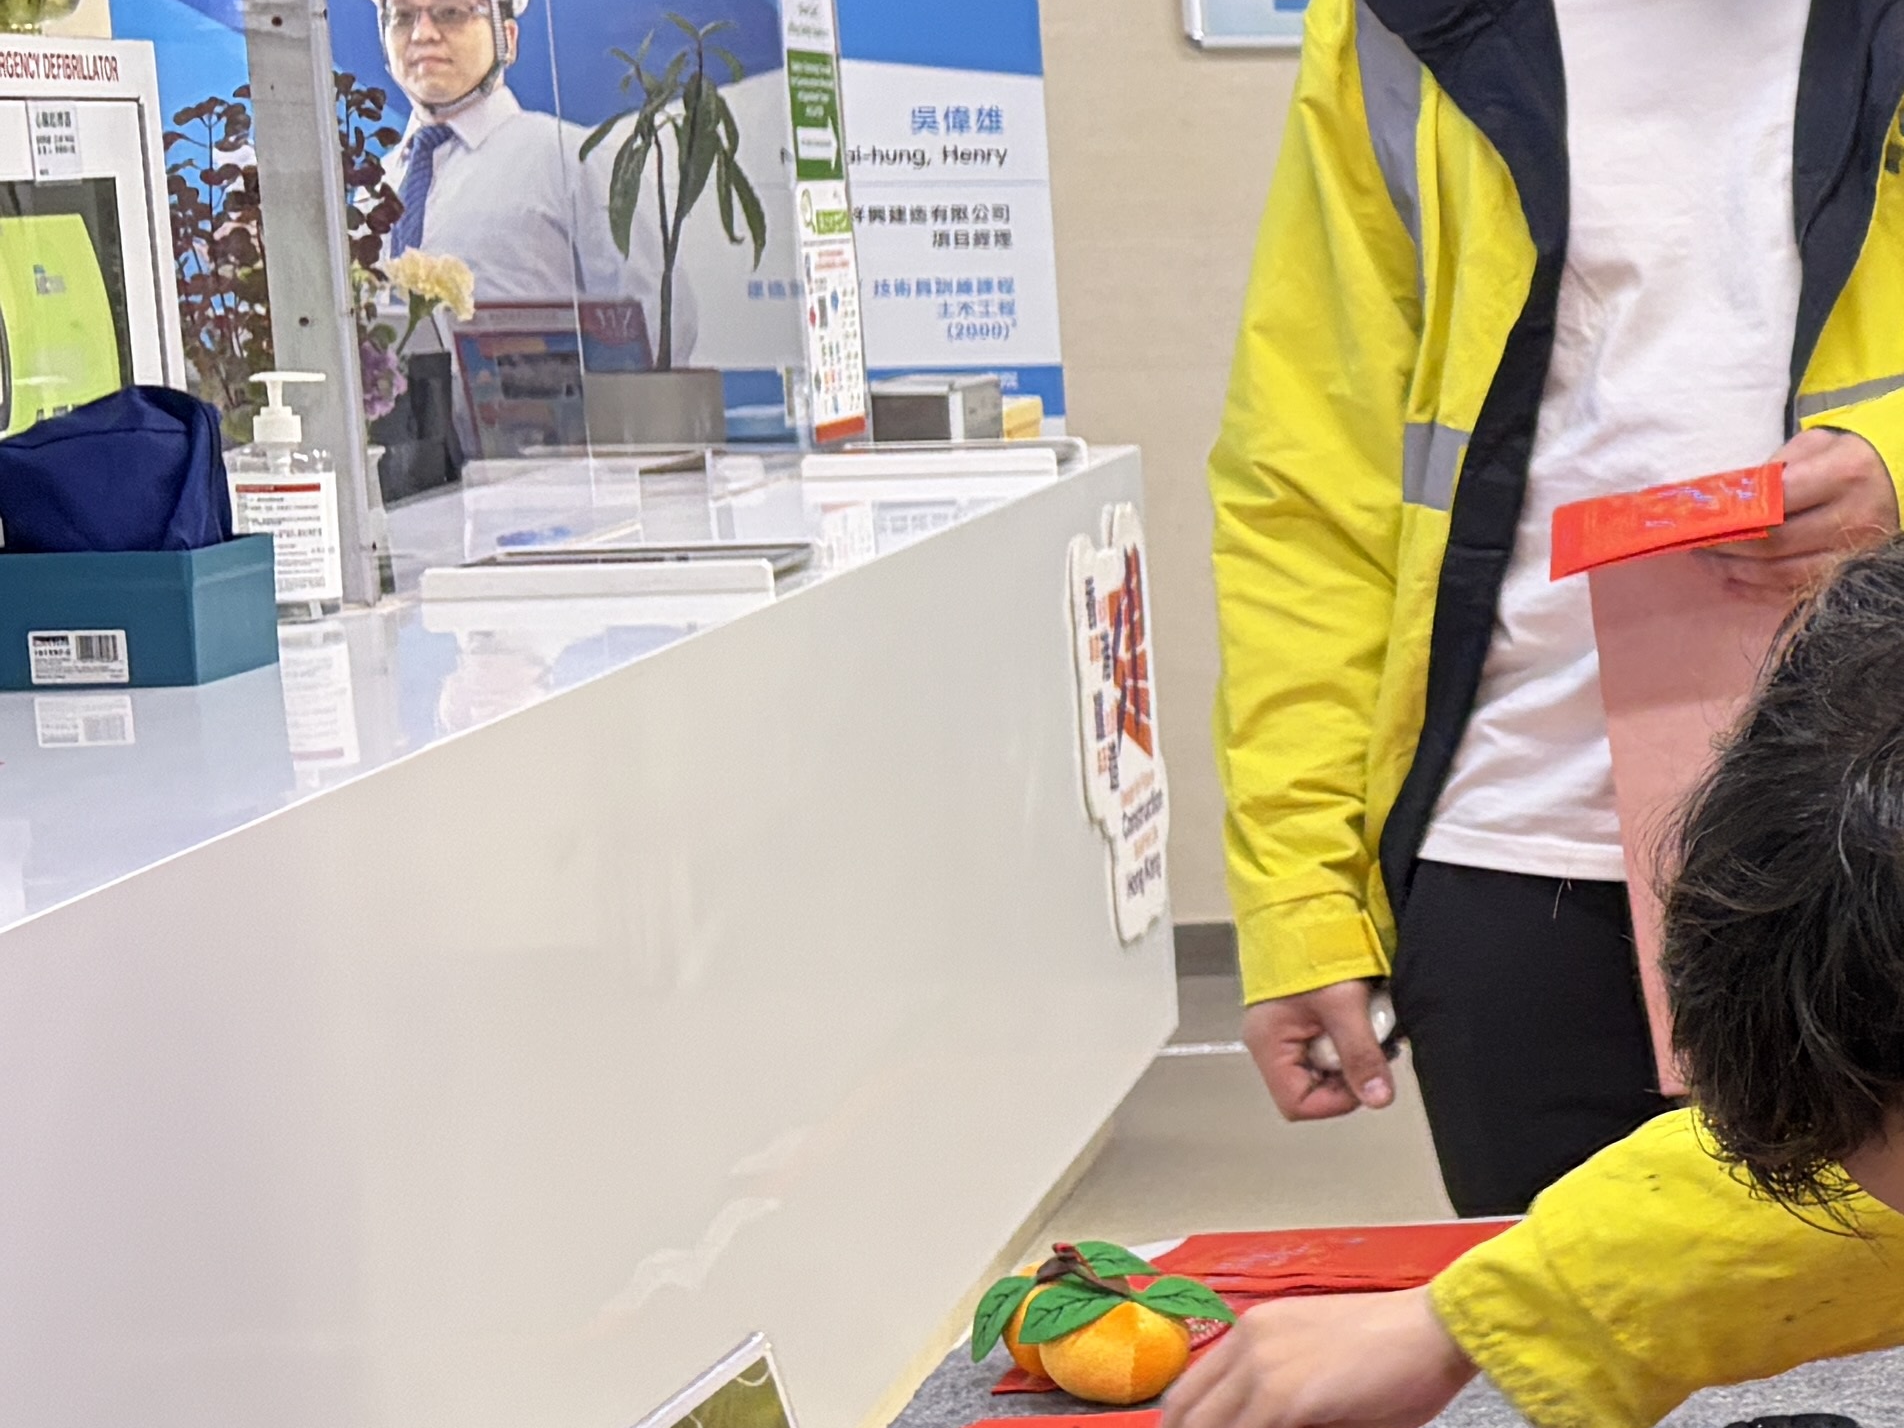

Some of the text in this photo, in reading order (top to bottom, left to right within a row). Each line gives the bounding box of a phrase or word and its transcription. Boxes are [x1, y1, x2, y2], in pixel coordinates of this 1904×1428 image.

[42, 52, 120, 82] DEFIBRILLATOR
[911, 105, 1005, 136] 吳偉雄
[847, 144, 1009, 170] ai-hung, Henry
